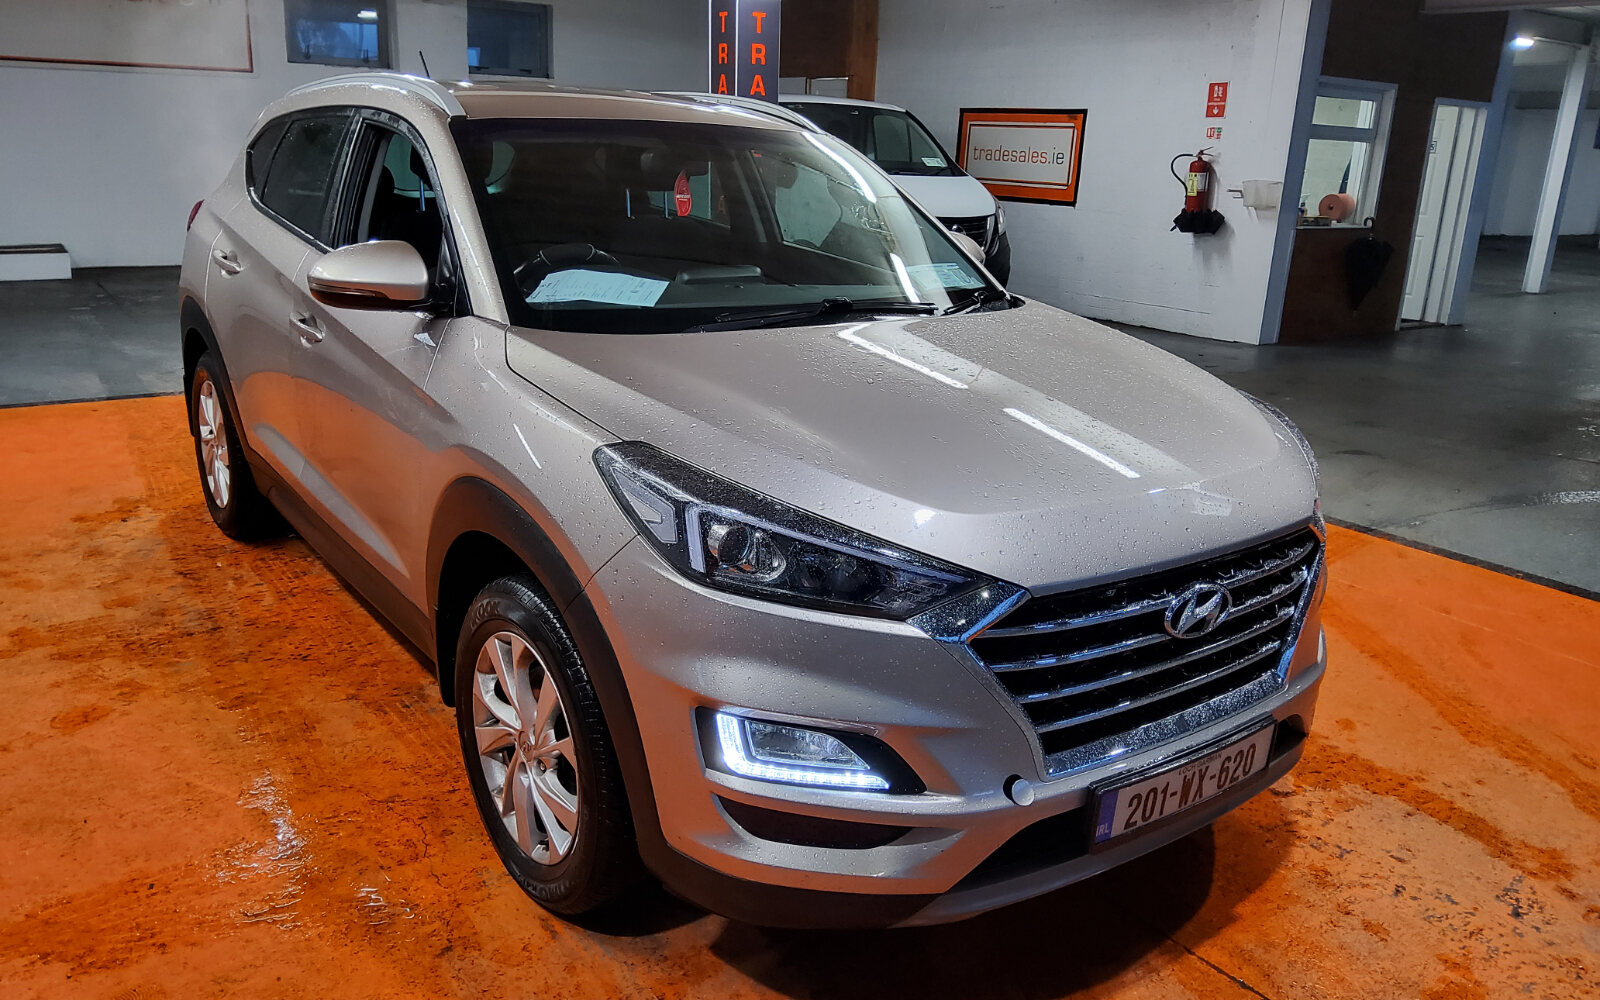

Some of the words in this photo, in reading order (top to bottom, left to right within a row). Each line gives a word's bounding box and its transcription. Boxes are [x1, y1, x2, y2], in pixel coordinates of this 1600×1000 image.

[718, 11, 729, 95] TRA
[750, 11, 767, 96] TRA
[973, 144, 1065, 165] tradesales.ie
[1124, 743, 1257, 830] 201-WX-620
[1095, 823, 1110, 837] IRL
